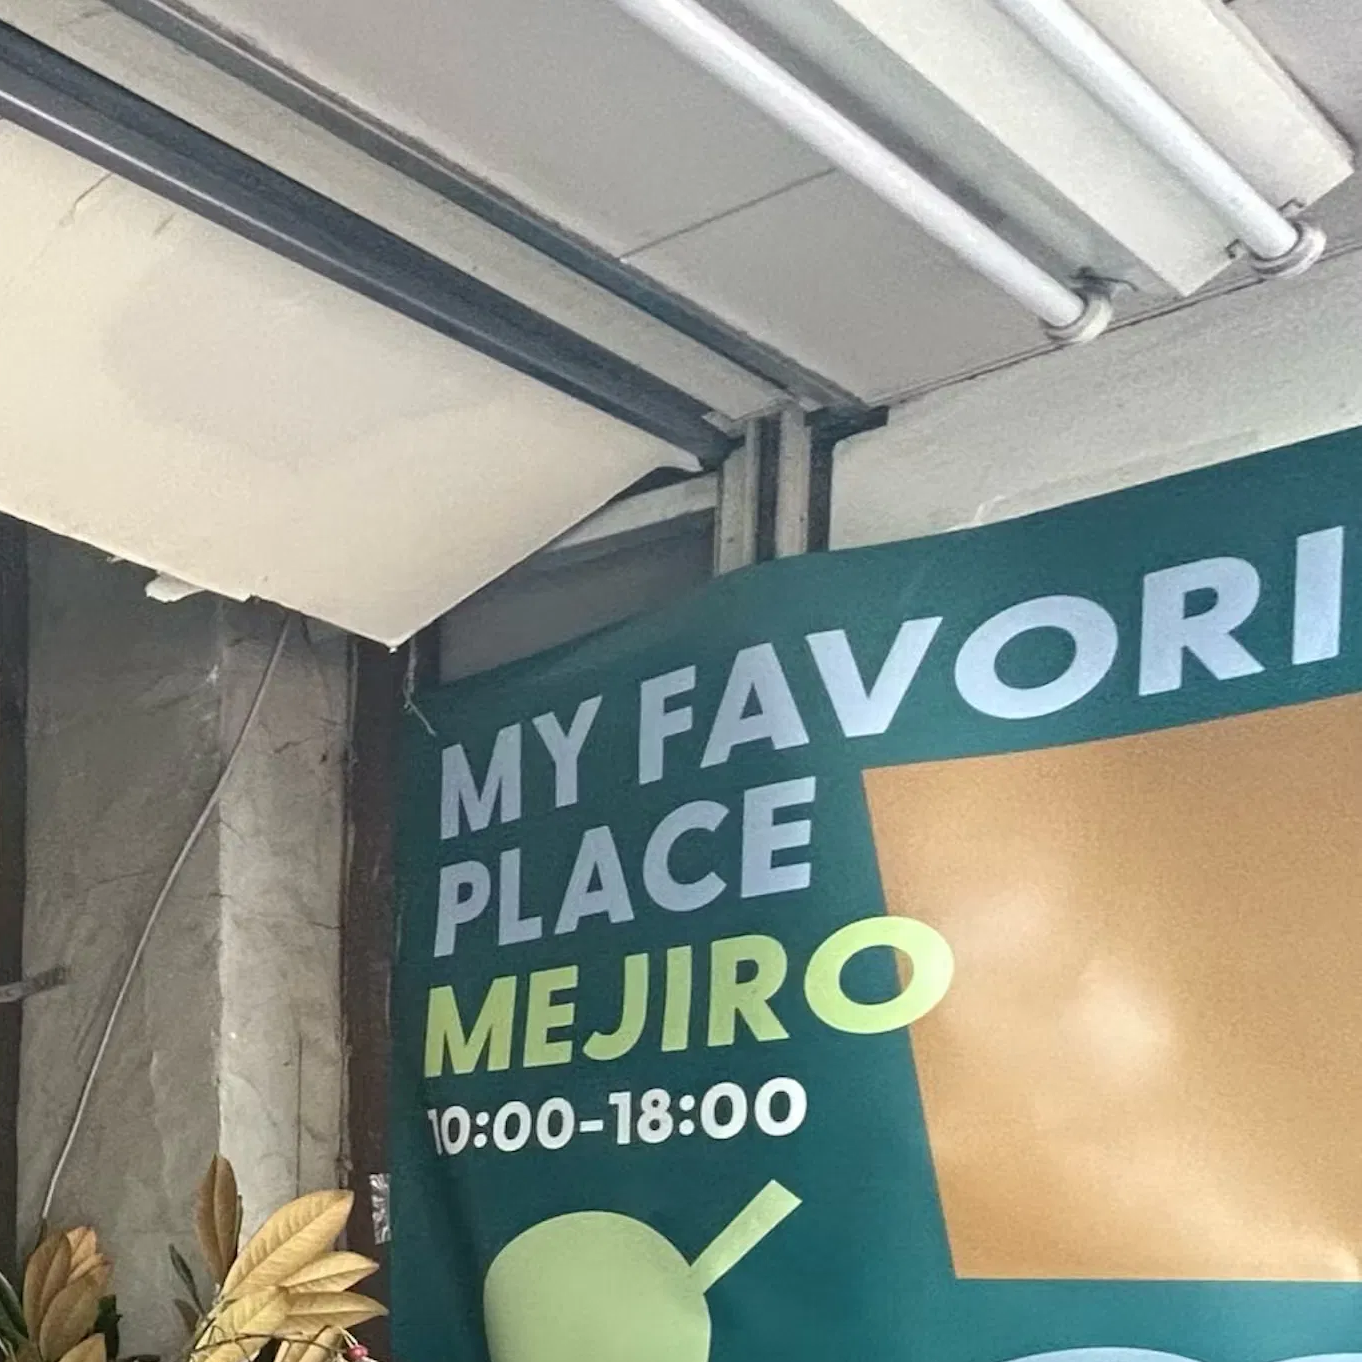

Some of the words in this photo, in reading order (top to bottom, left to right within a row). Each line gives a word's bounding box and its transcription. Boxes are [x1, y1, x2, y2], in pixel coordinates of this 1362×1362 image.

[439, 694, 603, 841] MY
[637, 525, 1344, 785] FAVORI
[432, 775, 817, 958] PLACE
[423, 916, 955, 1079] MEJIRO
[427, 1075, 808, 1157] 10:00-18:00
